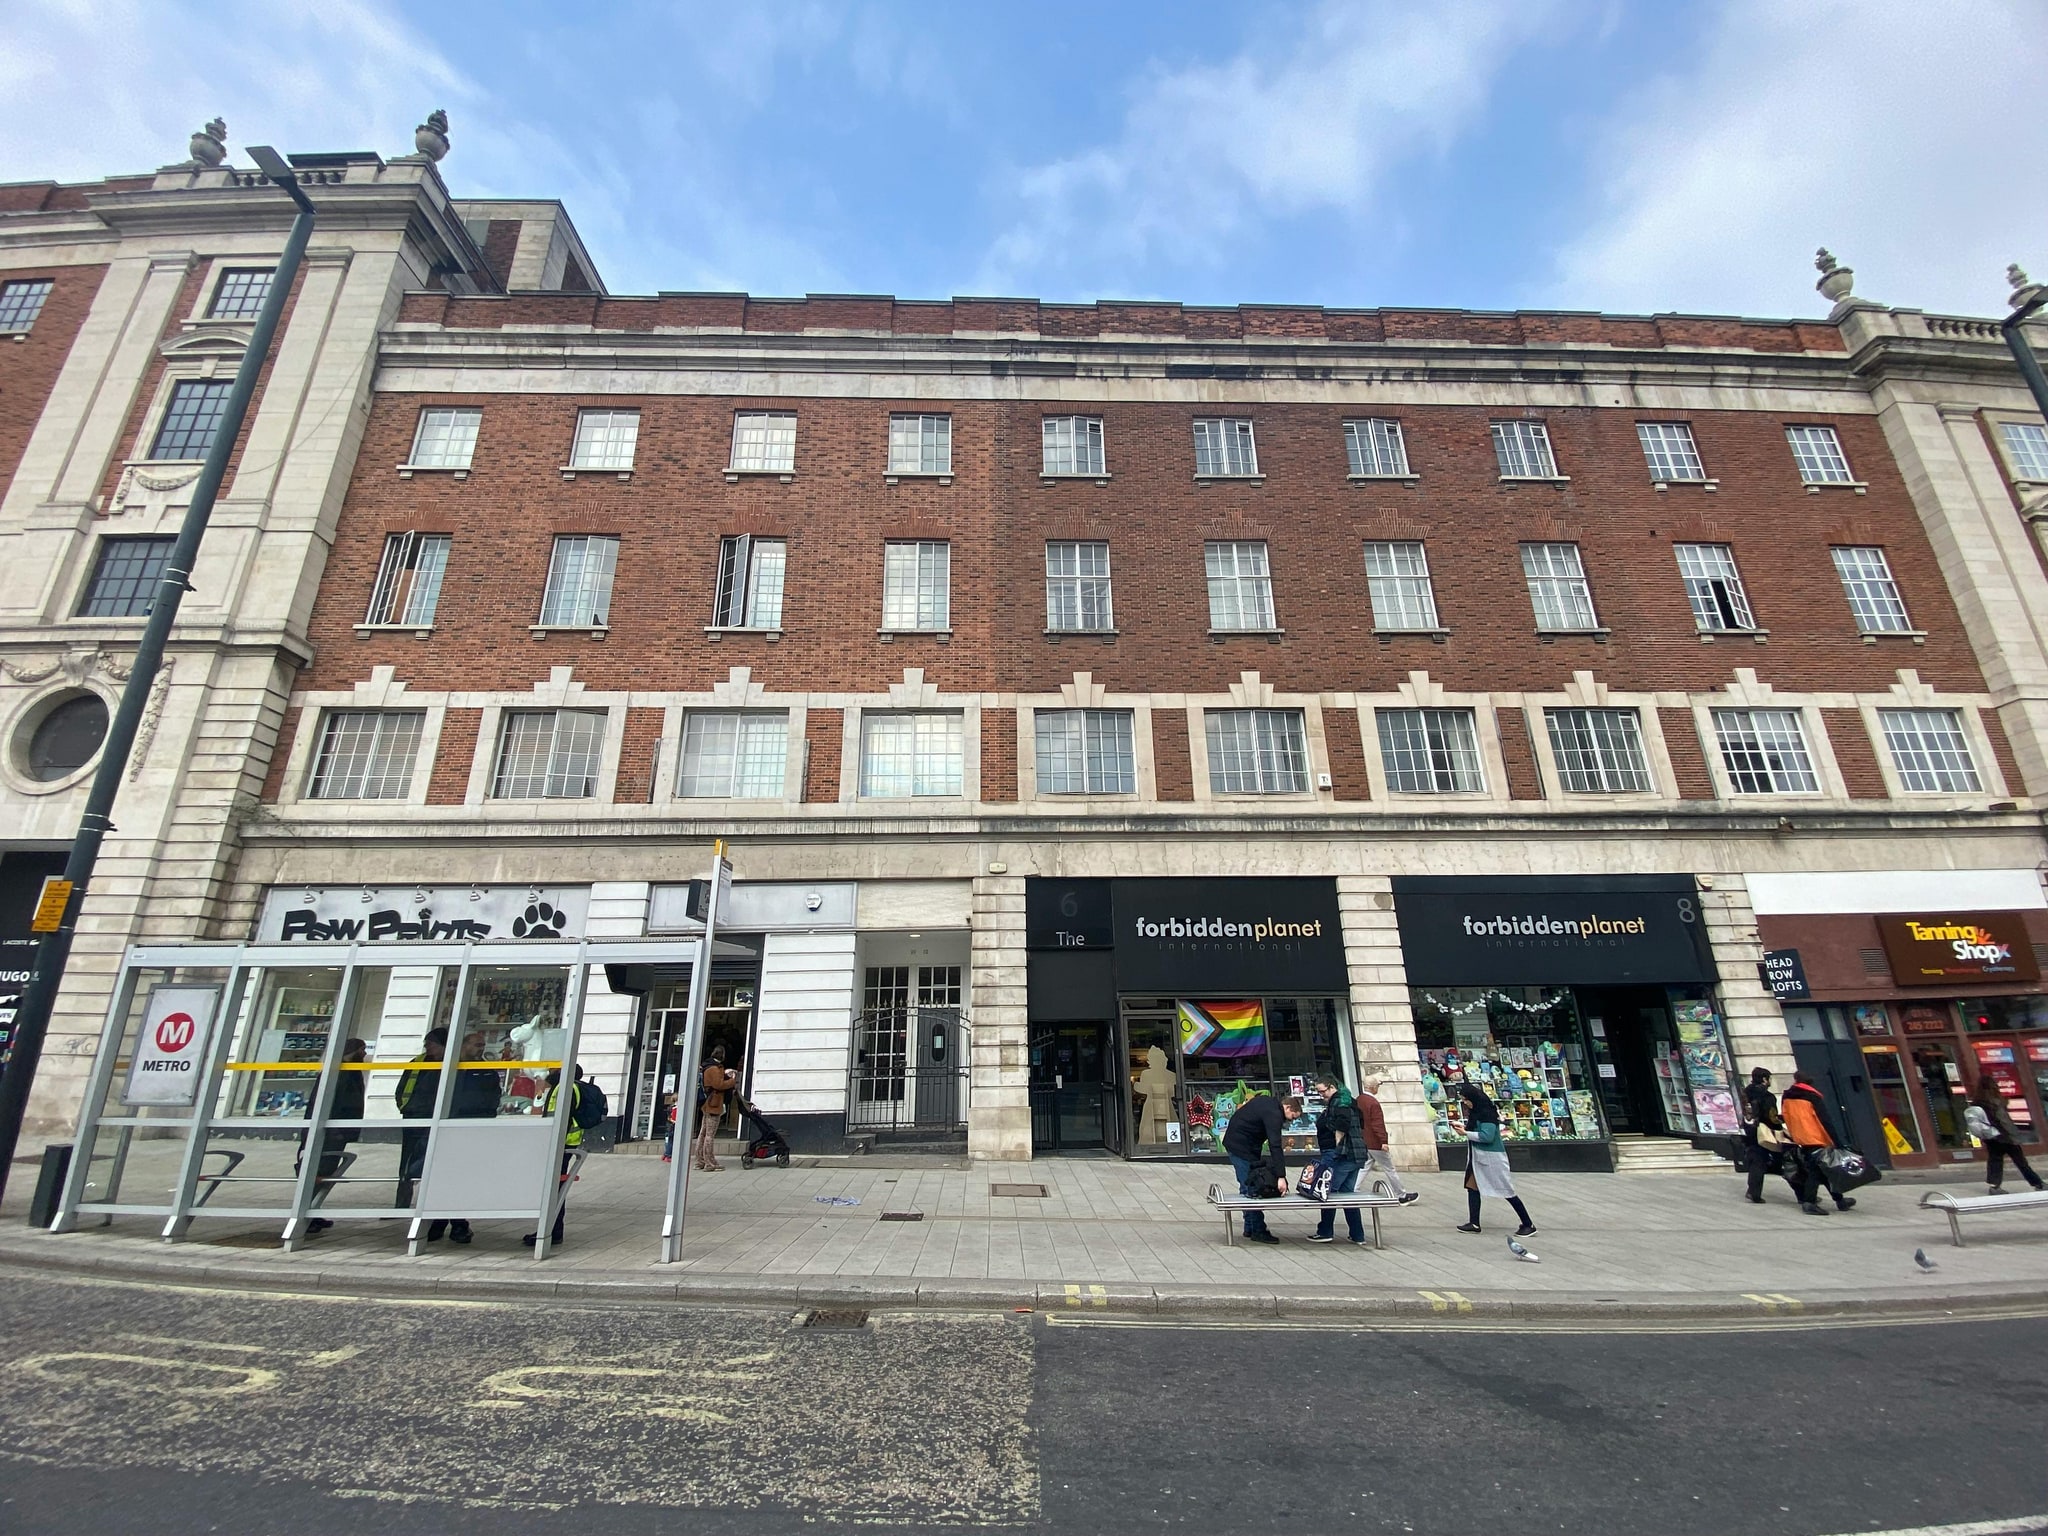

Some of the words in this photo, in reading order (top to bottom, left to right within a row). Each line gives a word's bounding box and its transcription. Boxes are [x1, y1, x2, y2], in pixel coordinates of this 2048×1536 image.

[1060, 891, 1078, 917] 6
[1677, 898, 1696, 923] 8
[1055, 931, 1085, 946] The
[1905, 921, 1977, 945] Tanning
[1159, 941, 1301, 950] international
[1486, 937, 1625, 948] international
[1952, 940, 2000, 964] Shop
[1765, 957, 1793, 969] HEAD
[0, 970, 30, 982] UGO
[1768, 969, 1793, 980] ROW
[1772, 980, 1802, 992] LOFTS
[1795, 1017, 1804, 1031] 4
[159, 1021, 191, 1044] M
[142, 1060, 191, 1072] METRO
